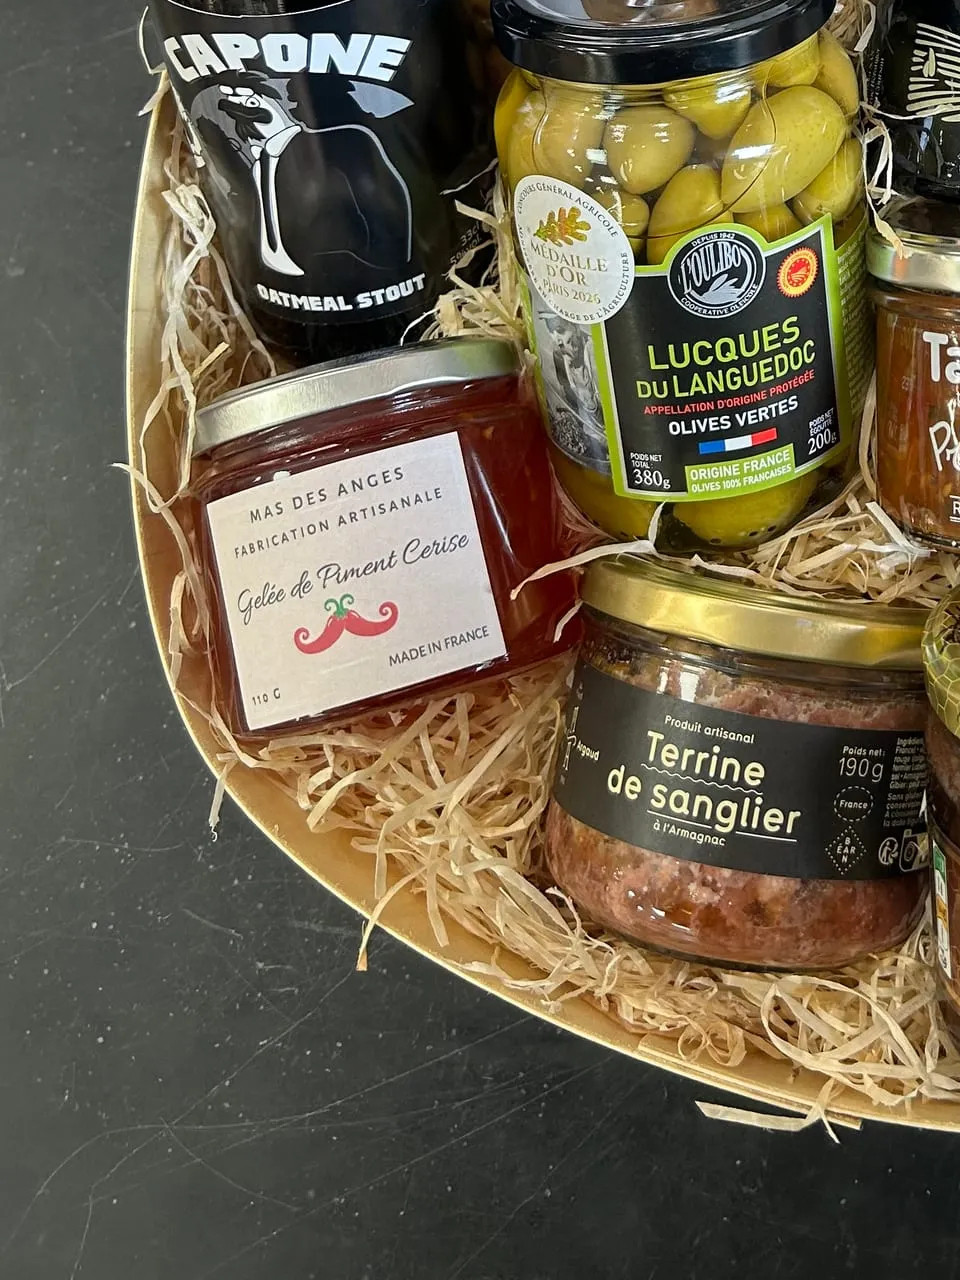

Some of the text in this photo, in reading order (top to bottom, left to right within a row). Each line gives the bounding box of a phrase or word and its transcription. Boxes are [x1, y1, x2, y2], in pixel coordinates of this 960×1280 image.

[163, 33, 413, 82] CAPONE
[536, 182, 574, 201] GÉNÉRAL
[575, 197, 619, 238] AGRICOLE
[530, 239, 608, 272] MÉDAILLE
[691, 232, 735, 247] DEPUIS 1942
[546, 263, 587, 287] D'OR
[597, 252, 628, 318] L'AGRICULTURE
[681, 241, 741, 294] L'OULIBO
[256, 273, 426, 312] OATMEAL STOUT
[543, 278, 569, 298] PARIS
[647, 315, 801, 371] LUCQUES
[636, 339, 816, 399] DU LANGUEDOC
[644, 368, 816, 415] APPELLATION D'ORIGINE PROTÉGÉE
[669, 395, 799, 436] OLIVES VERTES
[630, 452, 662, 462] POIDS NET
[807, 428, 837, 455] 200g
[633, 468, 671, 490] 380g
[690, 449, 791, 481] ORIGINE FRANCE
[249, 466, 405, 524] MAS DES ANGES
[691, 481, 721, 494] OLIVES
[722, 477, 741, 489] 100%
[233, 487, 443, 559] FABRICATION ARTISANALE
[237, 532, 470, 626] Gelée de Piment Cerise
[388, 625, 490, 668] MADE IN FRANCE
[251, 687, 282, 707] 110 G
[664, 715, 755, 744] Produit artisanal
[647, 730, 766, 787] Terrine
[842, 745, 867, 756] Poids
[607, 764, 801, 834] de sanglier
[839, 800, 869, 809] France
[653, 819, 727, 848] à l'Armagnac
